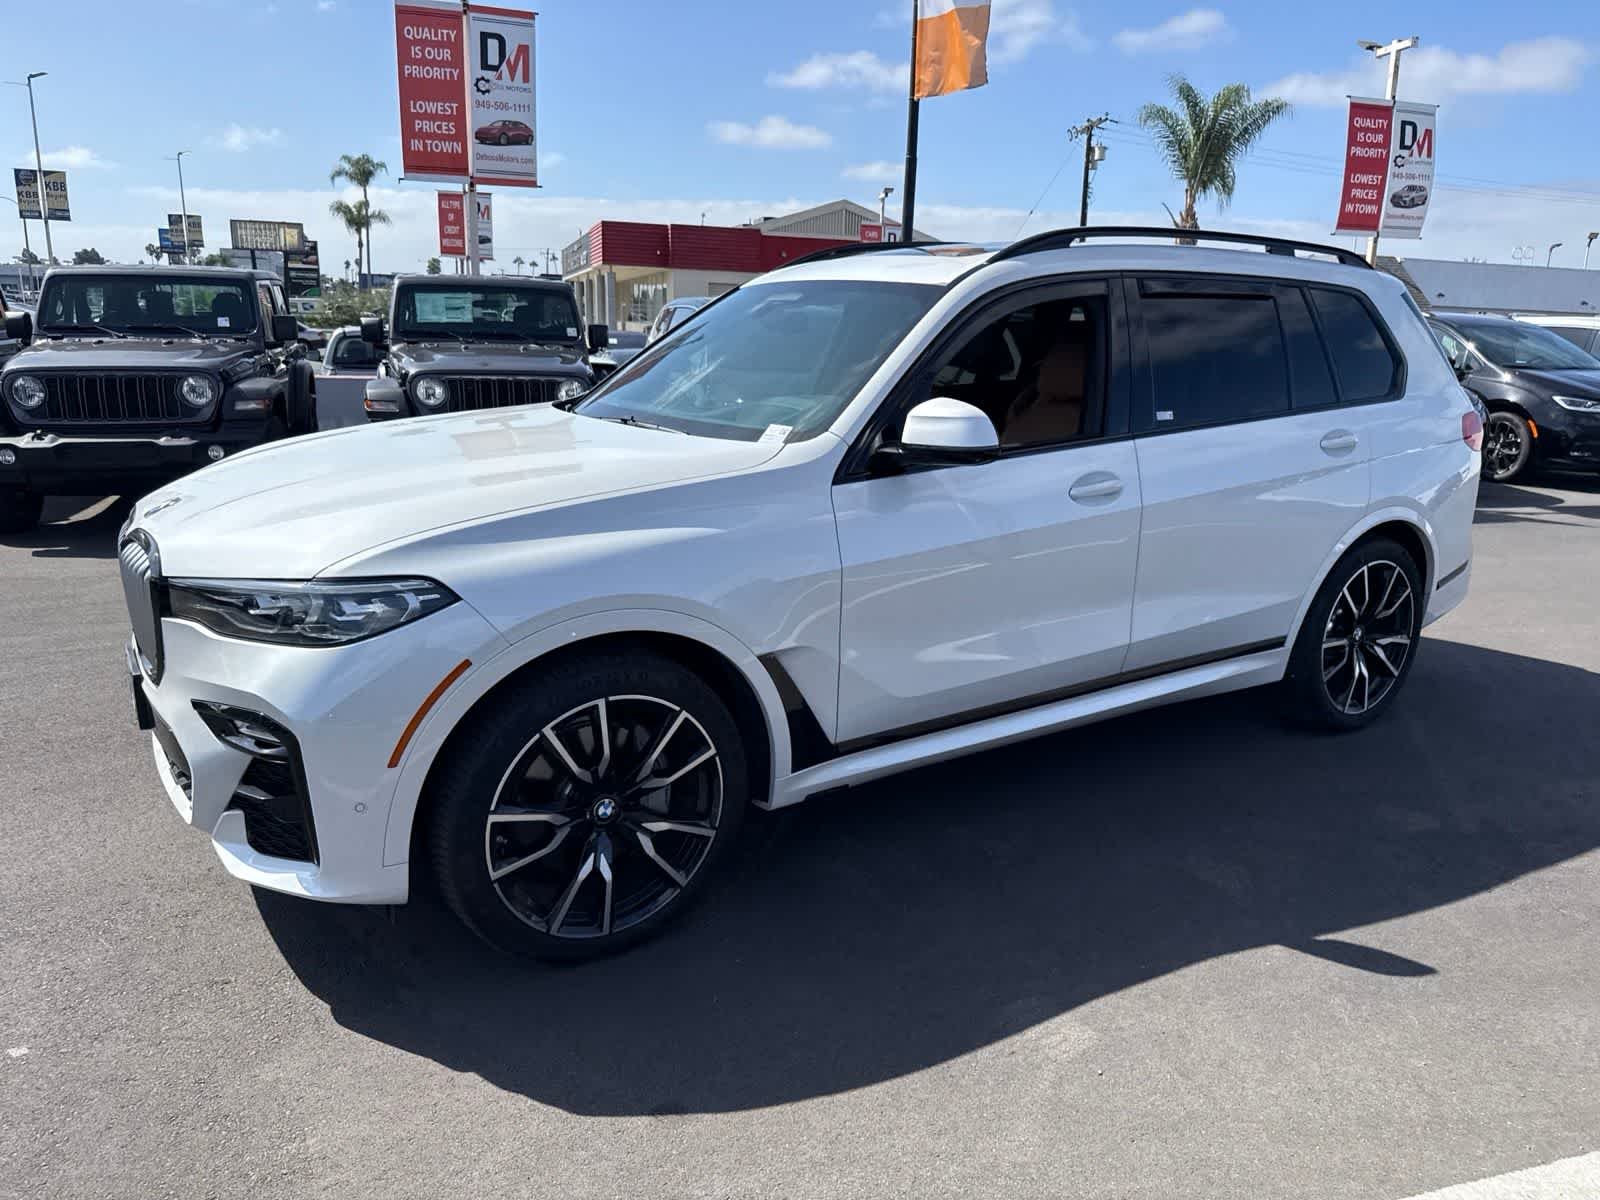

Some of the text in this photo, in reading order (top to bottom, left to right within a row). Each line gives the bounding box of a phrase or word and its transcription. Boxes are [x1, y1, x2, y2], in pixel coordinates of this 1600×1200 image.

[403, 25, 457, 43] QUALITY
[411, 45, 452, 61] IS OUR
[404, 64, 460, 81] PRIORITY
[410, 100, 458, 116] LOWEST
[415, 119, 456, 135] PRICES
[1353, 117, 1388, 129] QUALITY
[1357, 132, 1384, 144] IS OUR
[410, 138, 462, 154] IN TOWN
[1350, 146, 1388, 159] PRIORITY
[1350, 173, 1383, 185] LOWEST
[45, 181, 66, 192] KBB
[1351, 188, 1377, 200] PRICES
[1345, 202, 1379, 215] IN TOWN
